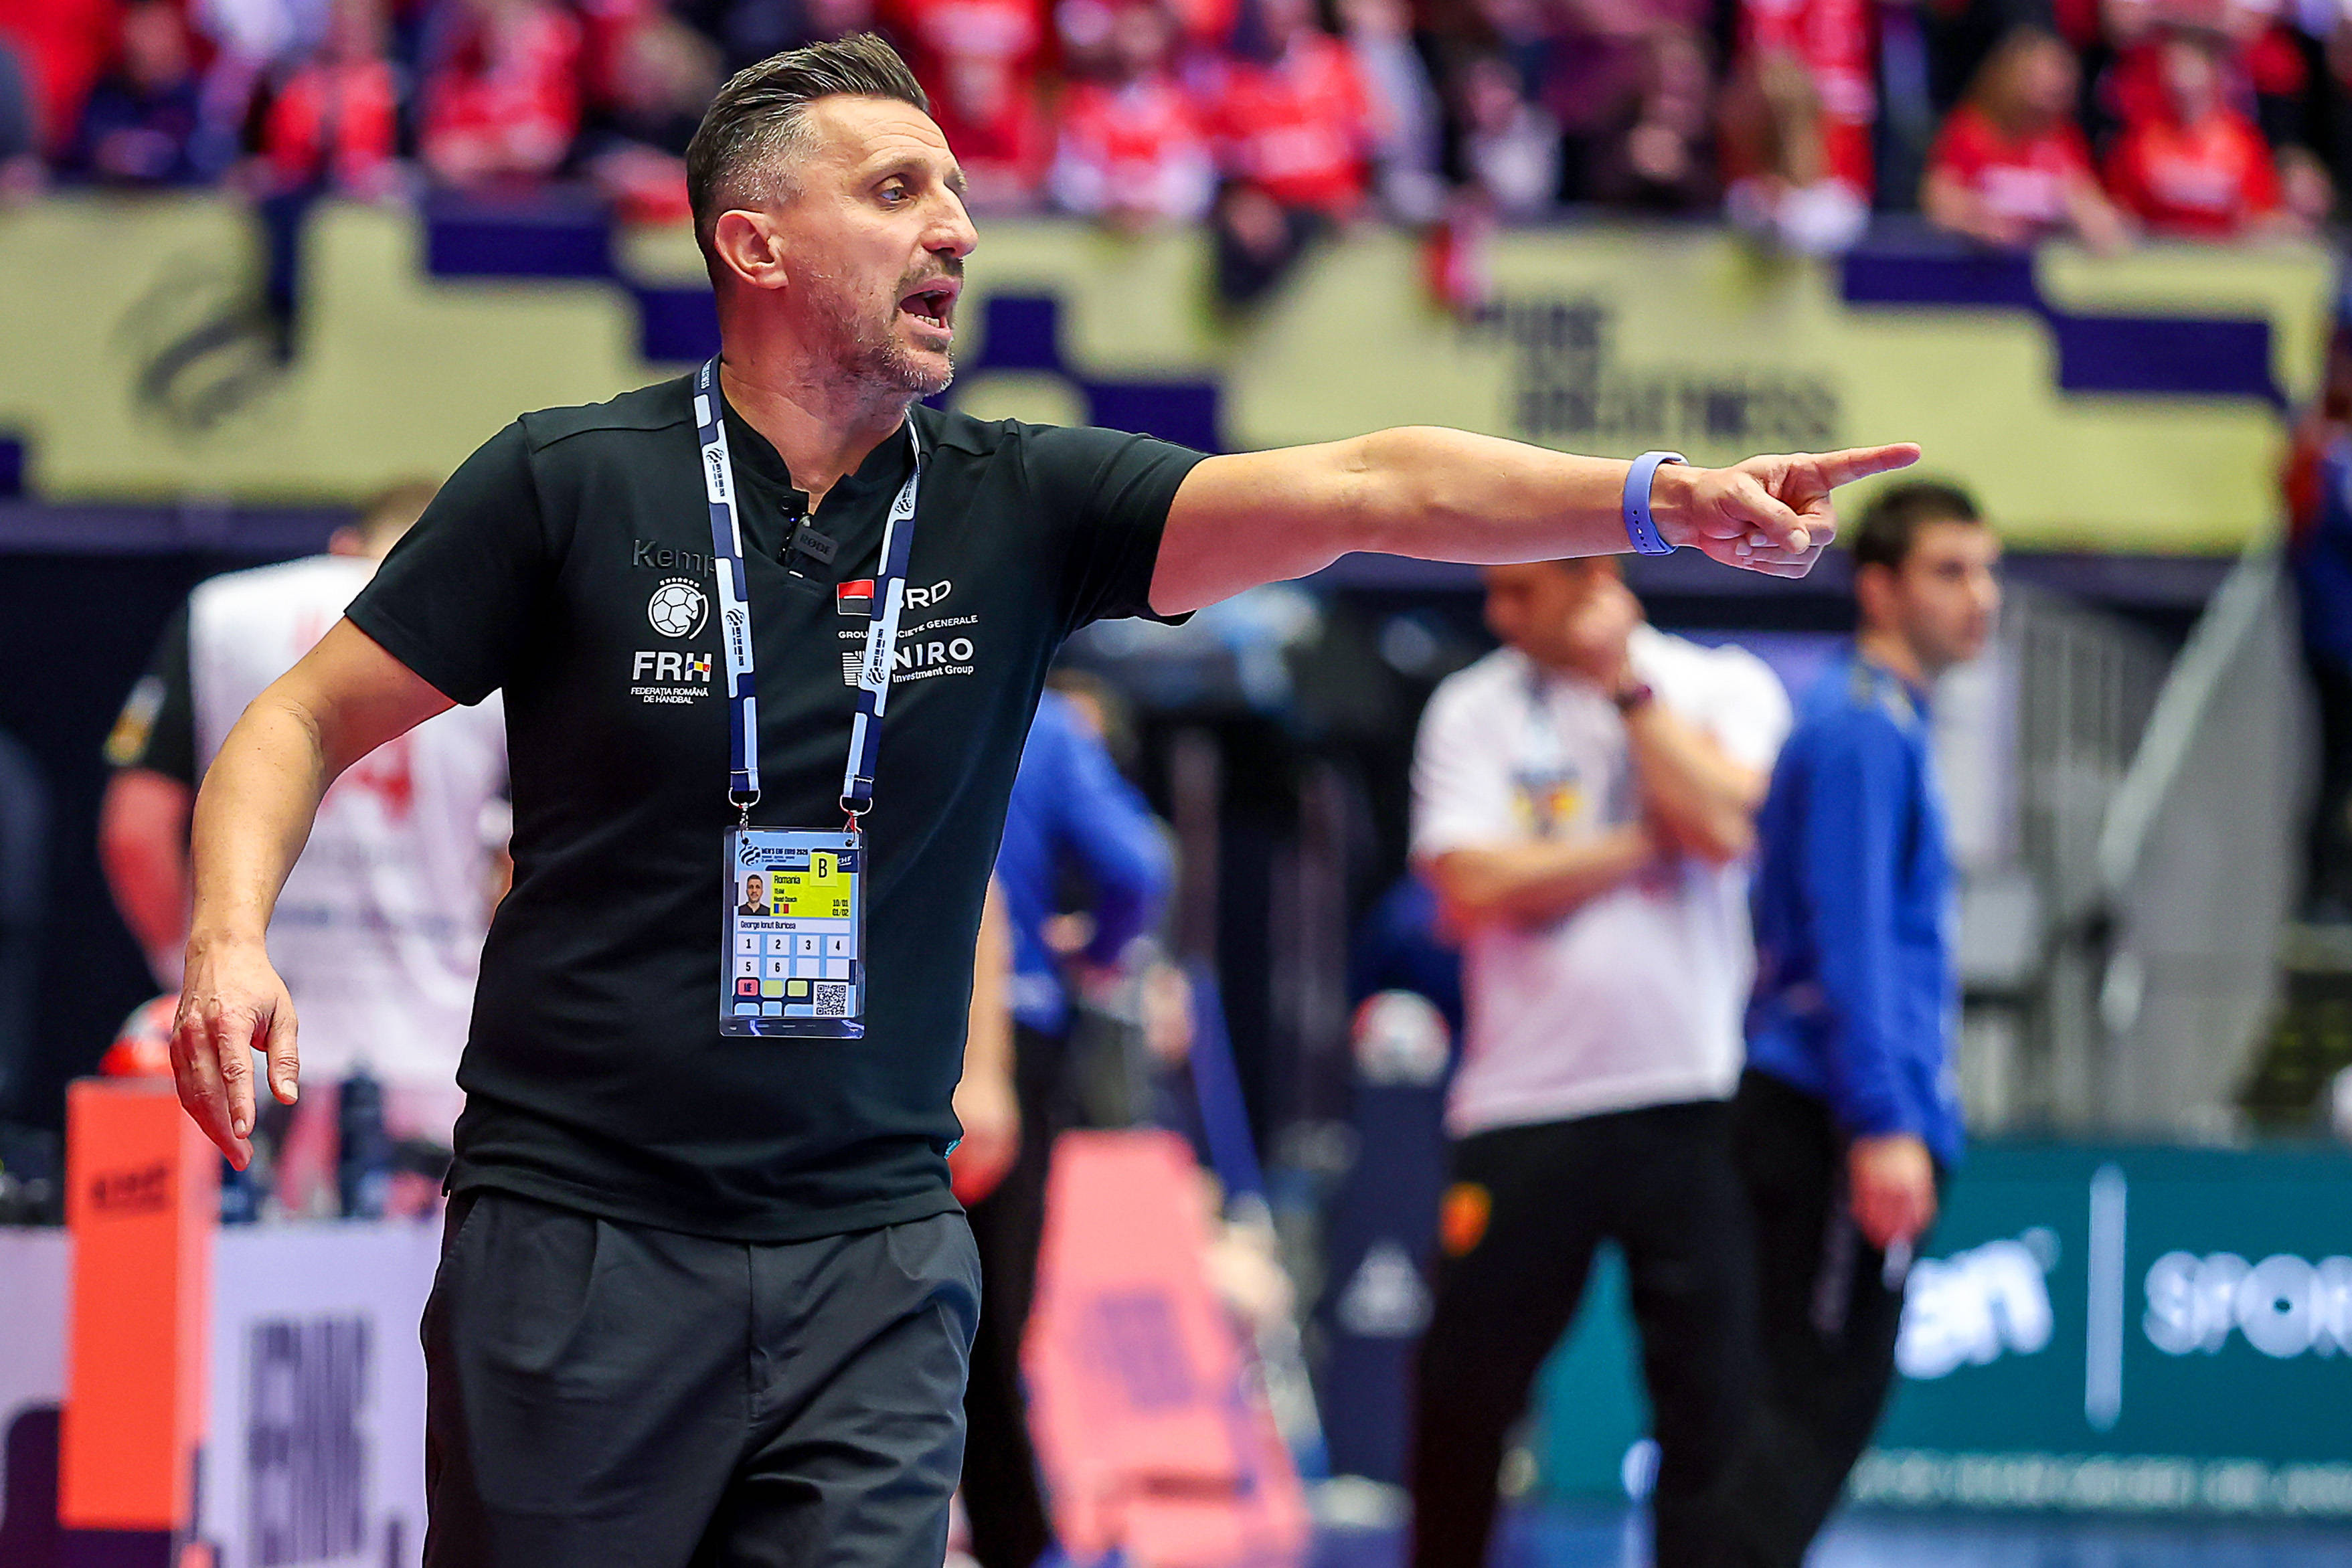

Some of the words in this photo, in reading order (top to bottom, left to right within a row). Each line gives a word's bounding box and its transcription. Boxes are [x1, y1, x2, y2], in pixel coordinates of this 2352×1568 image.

[633, 539, 715, 578] Kemp
[900, 580, 952, 610] RD
[896, 624, 925, 638] CIETE
[926, 614, 979, 630] GENERALE
[633, 651, 711, 682] FRH
[892, 667, 944, 683] Investment
[944, 665, 974, 675] Group
[819, 858, 827, 878] B
[774, 875, 801, 884] Romania
[741, 921, 760, 930] George
[746, 939, 751, 948] 1
[776, 939, 780, 949] 2
[806, 940, 811, 950] 3
[835, 941, 840, 950] 4
[746, 962, 751, 971] 5
[775, 962, 780, 972] 6
